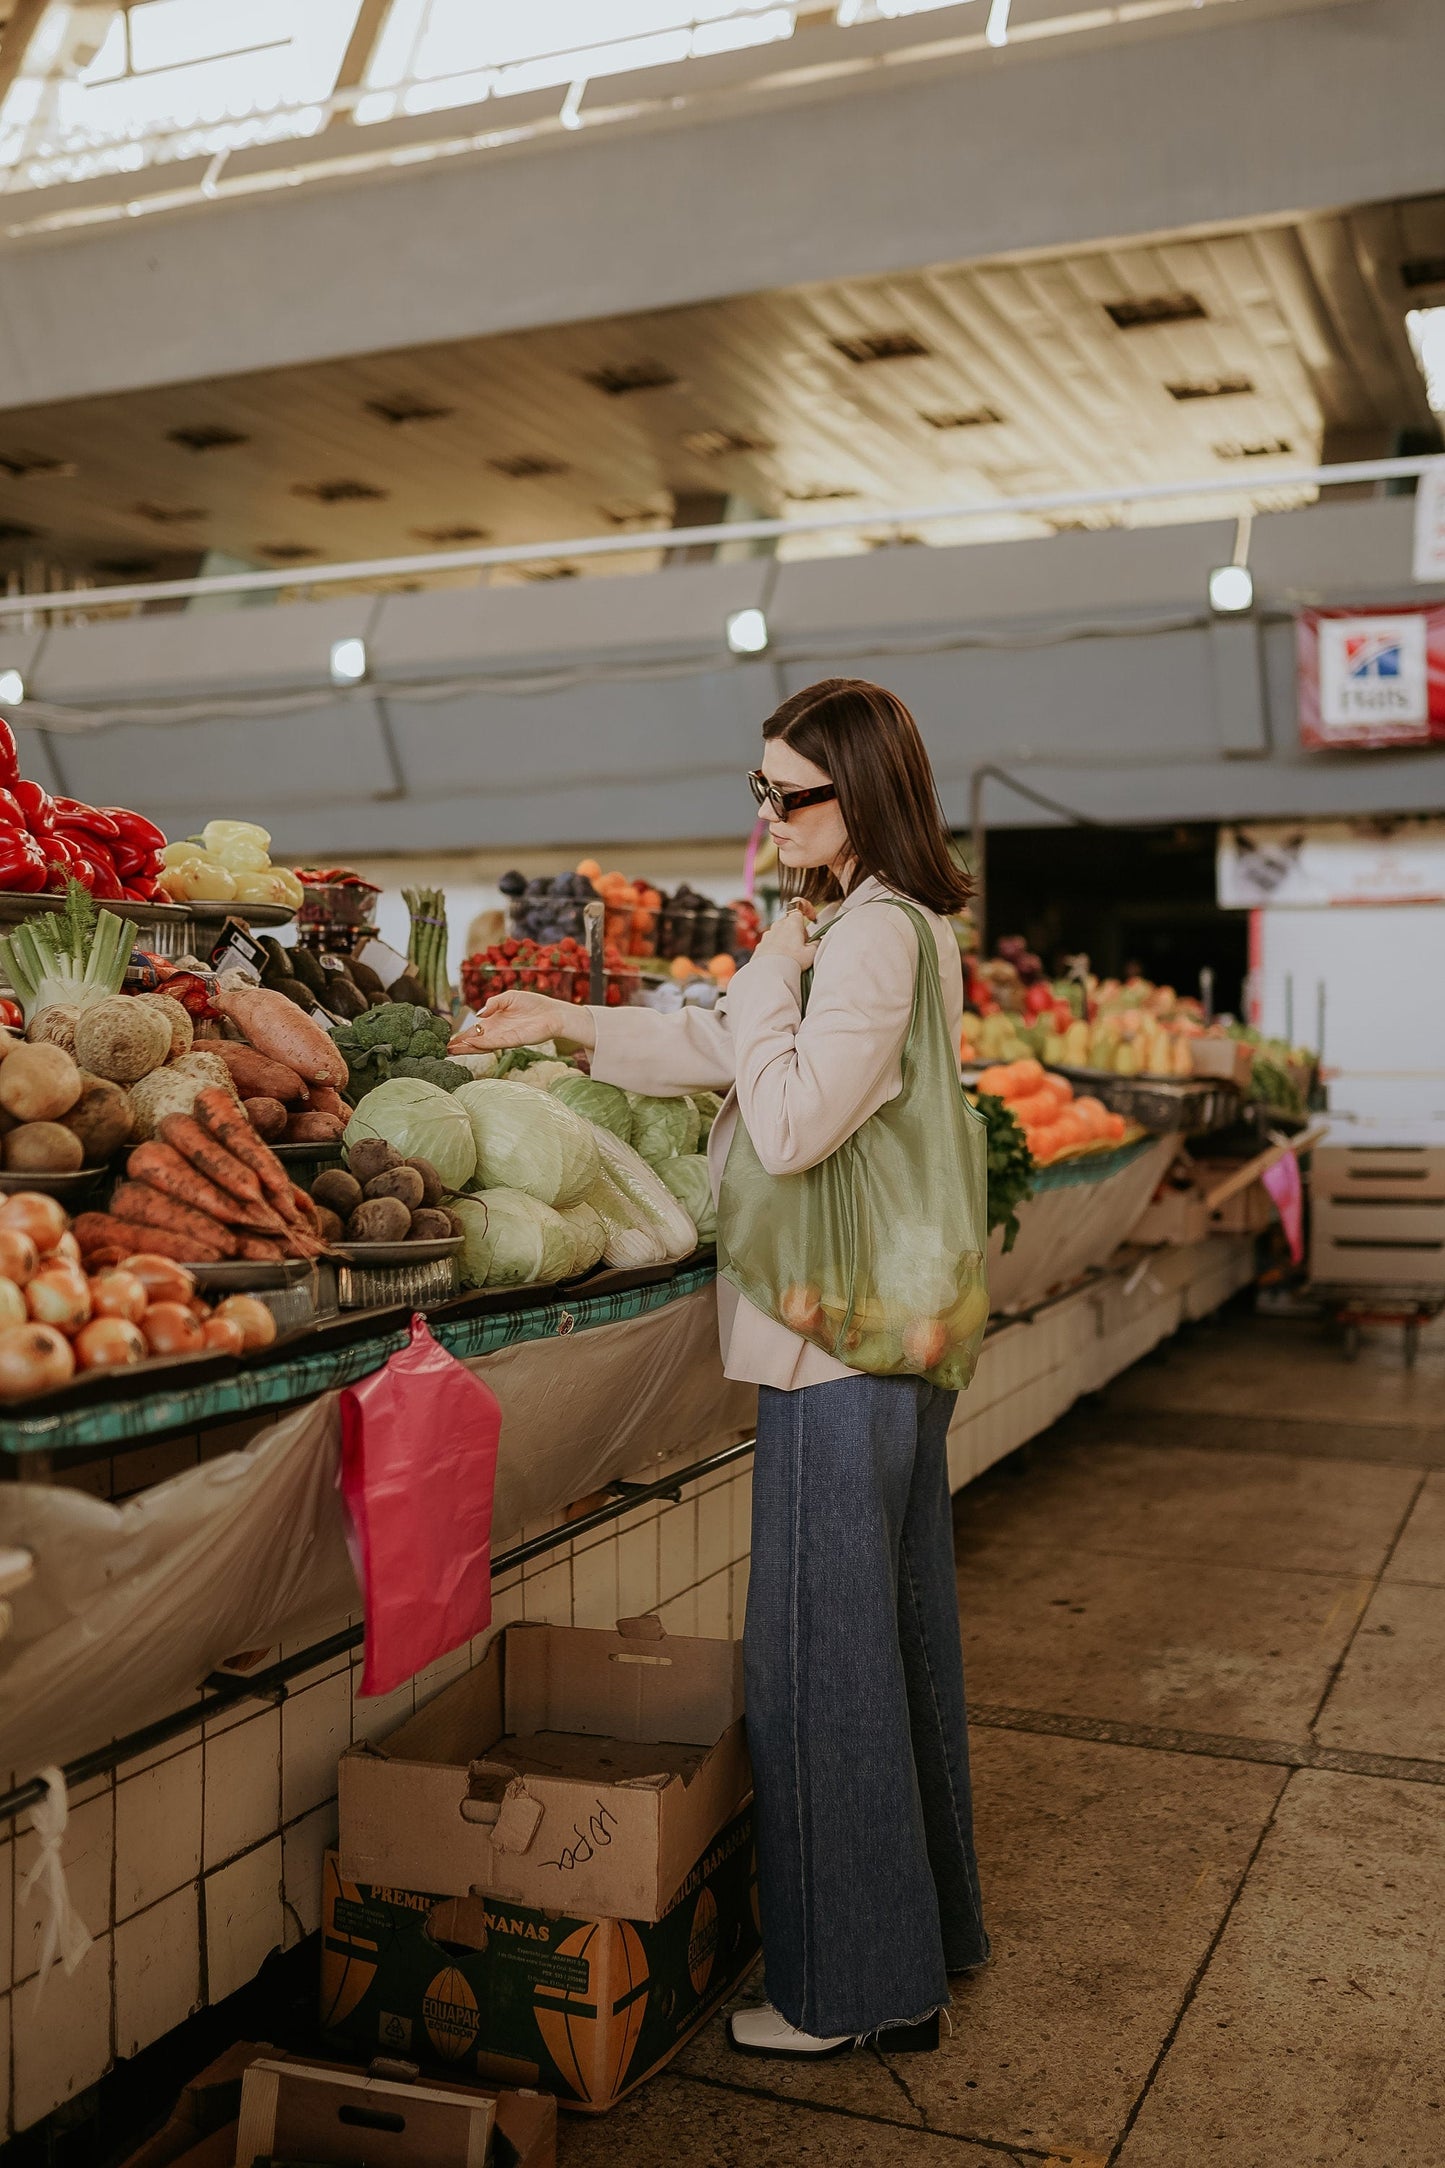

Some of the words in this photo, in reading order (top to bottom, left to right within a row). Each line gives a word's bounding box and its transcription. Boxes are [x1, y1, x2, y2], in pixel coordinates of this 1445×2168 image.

[482, 1911, 551, 1942] NANAS
[423, 1998, 481, 2030] EQUAPAK
[428, 2018, 474, 2040] ECUADOR
